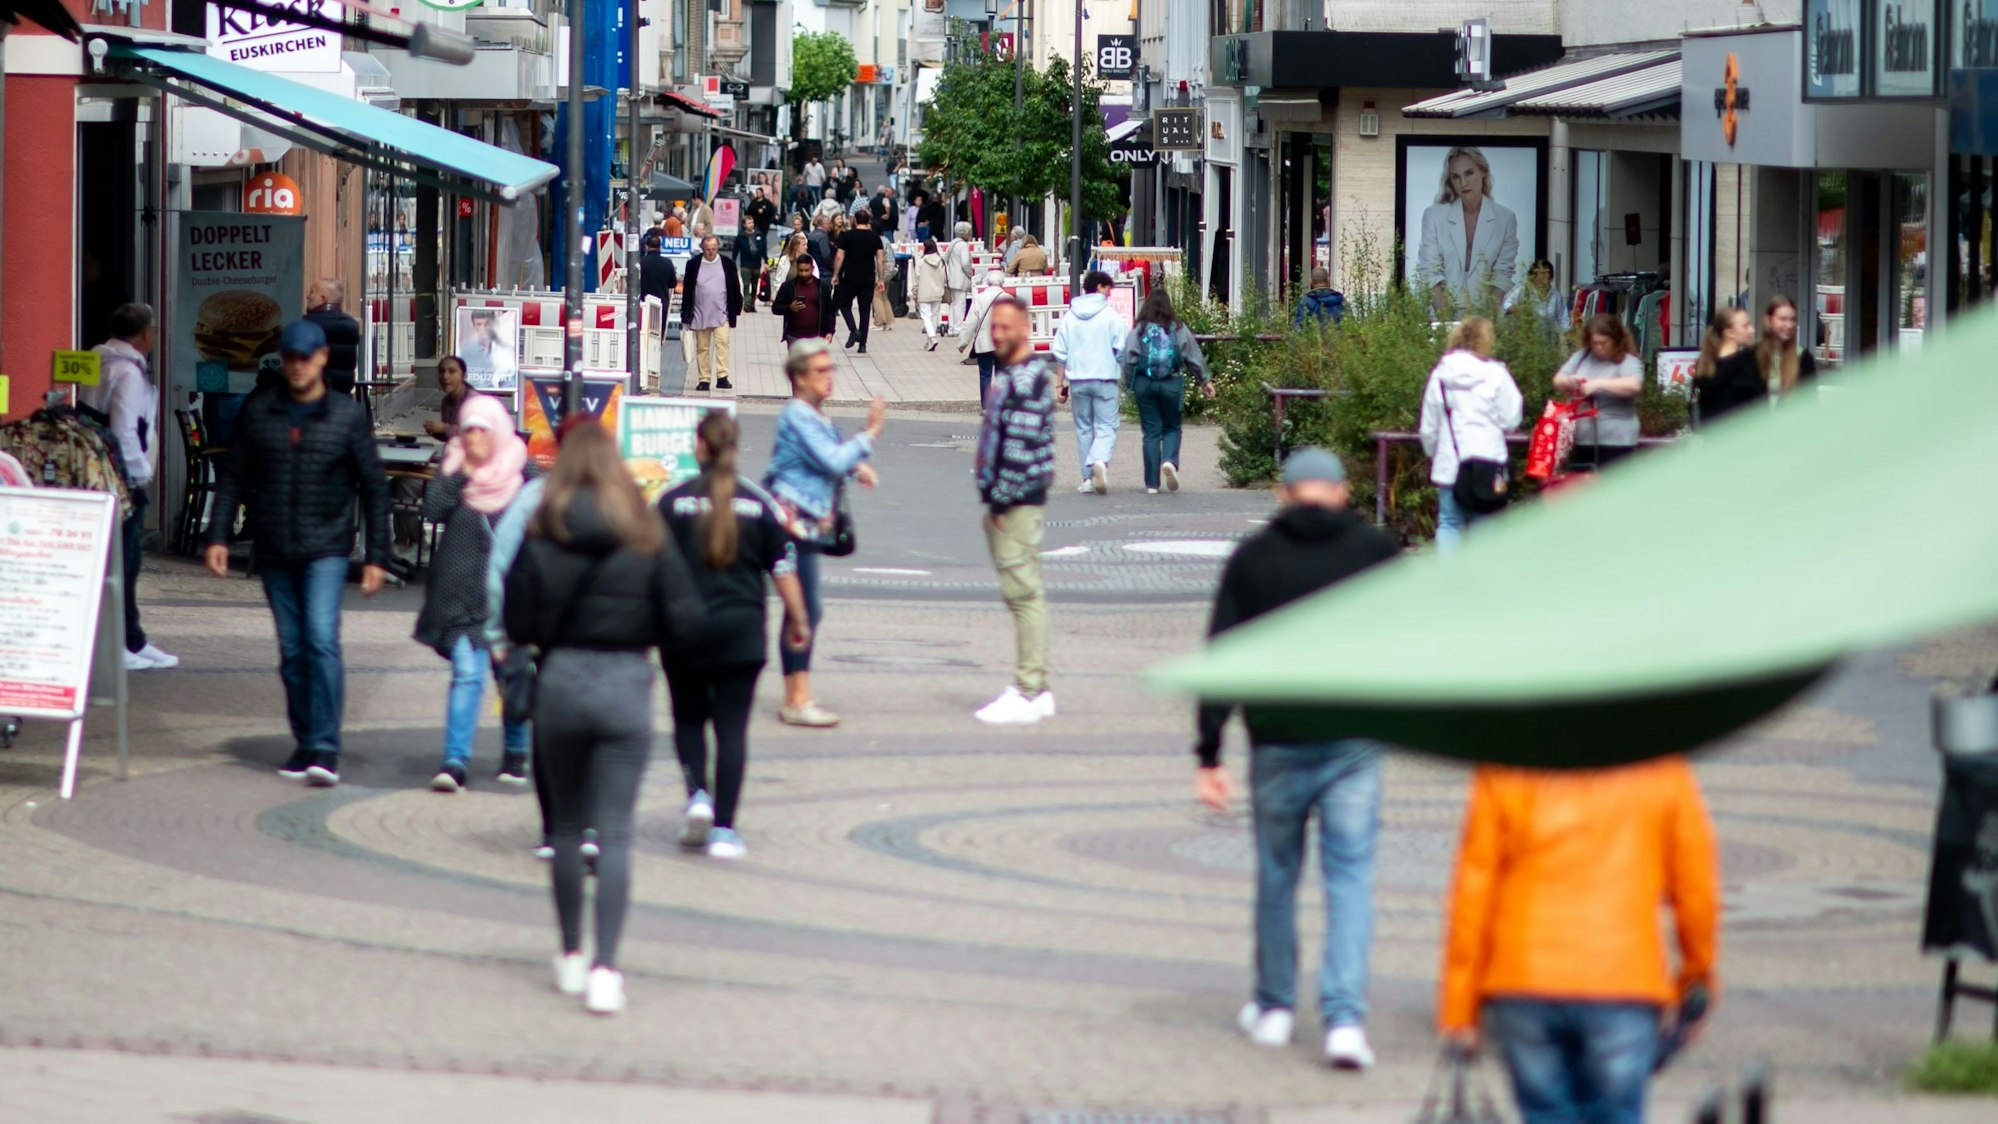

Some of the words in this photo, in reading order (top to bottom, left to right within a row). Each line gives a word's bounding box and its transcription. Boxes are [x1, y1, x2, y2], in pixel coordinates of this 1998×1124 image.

[230, 35, 327, 62] EUSKIRCHEN
[1100, 46, 1132, 68] BB
[1110, 149, 1155, 162] ONLY
[249, 178, 294, 208] ria
[190, 225, 272, 245] DOPPELT
[664, 237, 689, 248] NEU
[191, 251, 262, 271] LECKER
[61, 360, 92, 376] 30%
